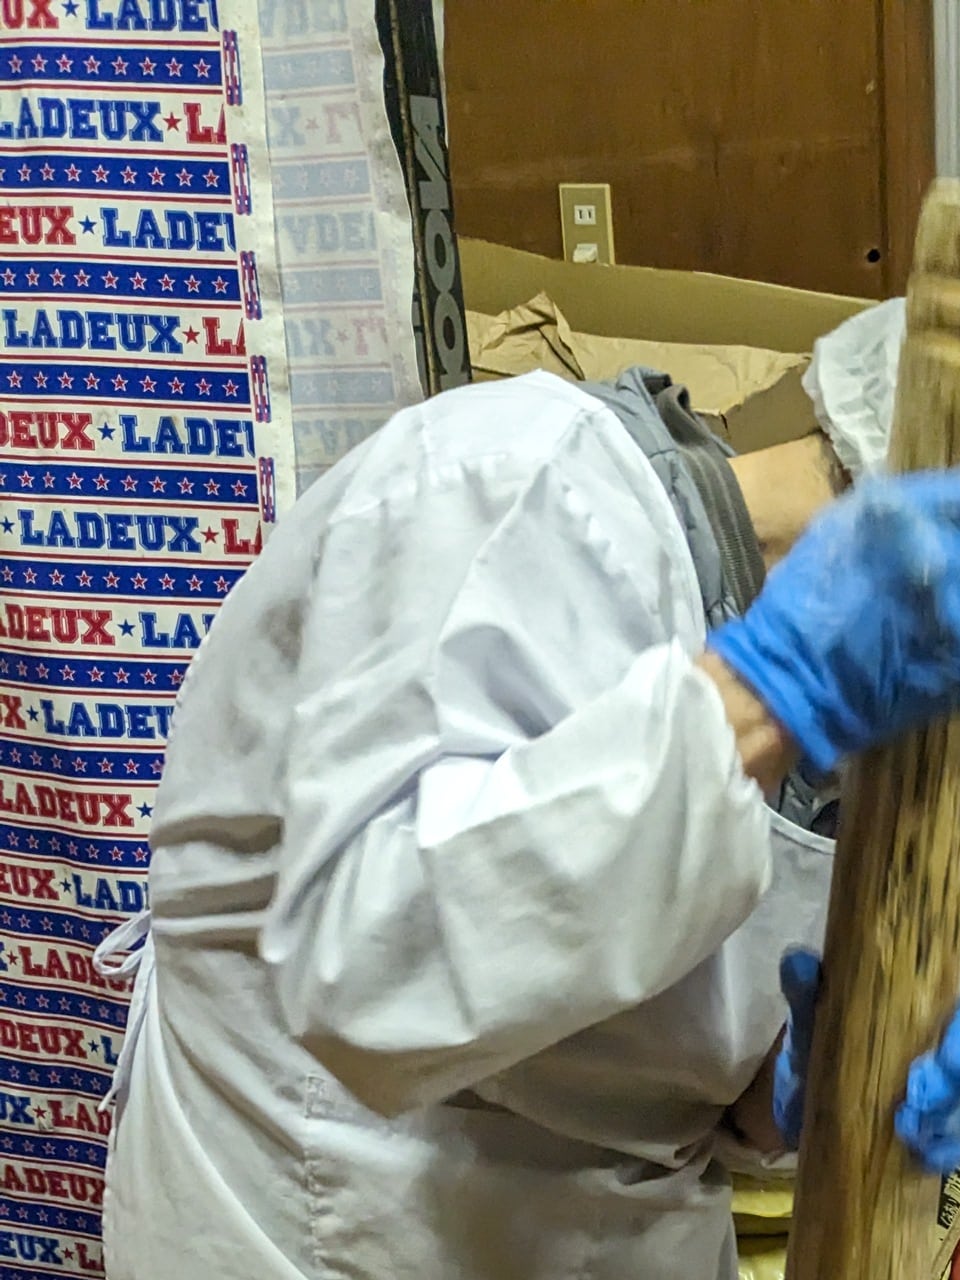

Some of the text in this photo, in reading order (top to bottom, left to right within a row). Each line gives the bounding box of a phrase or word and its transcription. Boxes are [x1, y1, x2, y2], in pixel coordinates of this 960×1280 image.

[2, 308, 184, 354] LADEUX
[17, 509, 202, 553] LADEUX
[0, 603, 116, 646] DEUX
[72, 873, 149, 913] LAD
